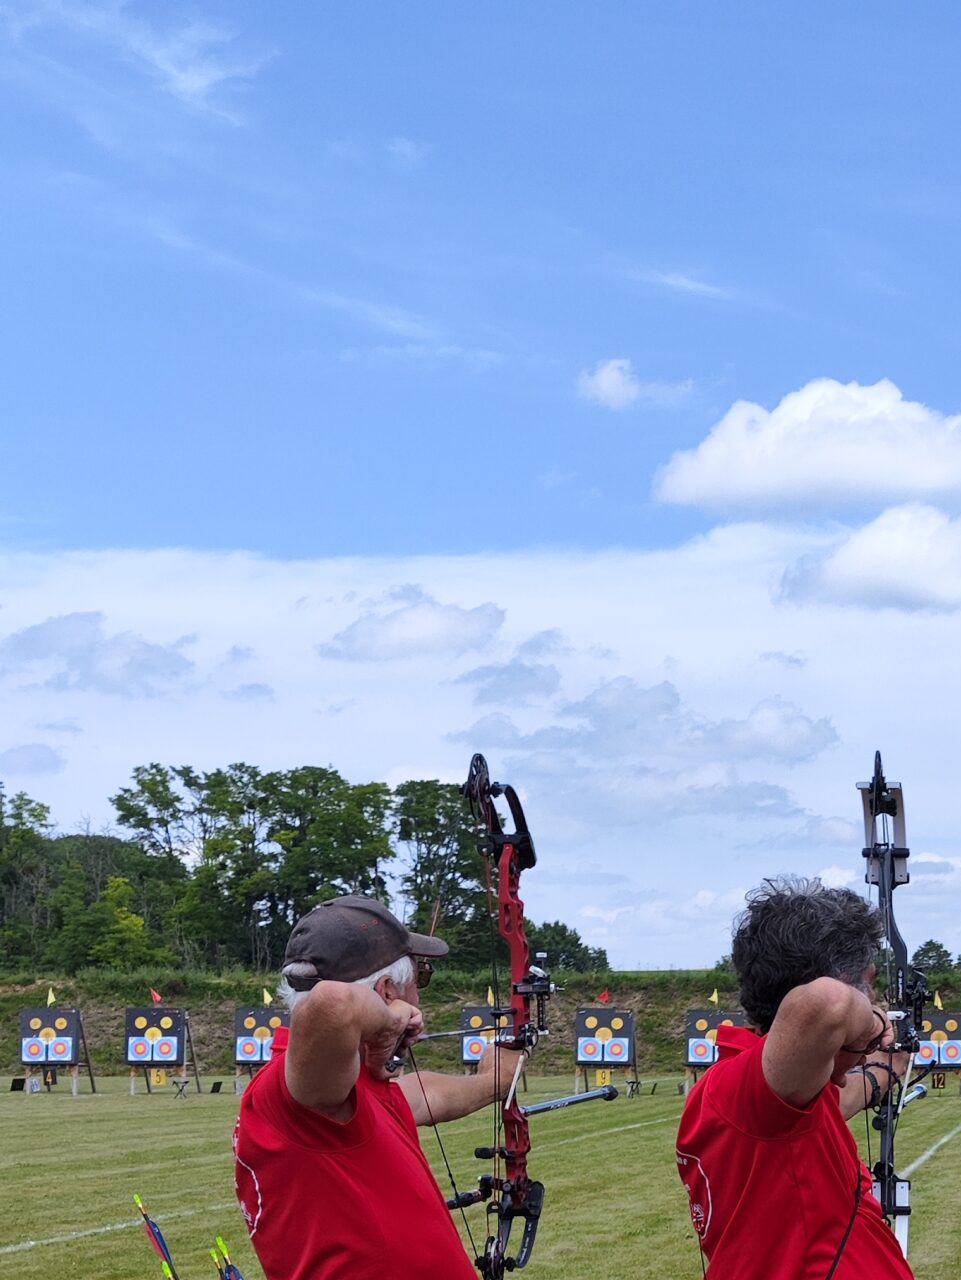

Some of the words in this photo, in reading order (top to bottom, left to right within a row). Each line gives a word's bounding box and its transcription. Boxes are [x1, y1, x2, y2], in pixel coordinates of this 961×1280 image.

[46, 1070, 52, 1084] 4
[155, 1070, 161, 1084] 5
[601, 1070, 607, 1084] 9
[933, 1073, 945, 1088] 12
